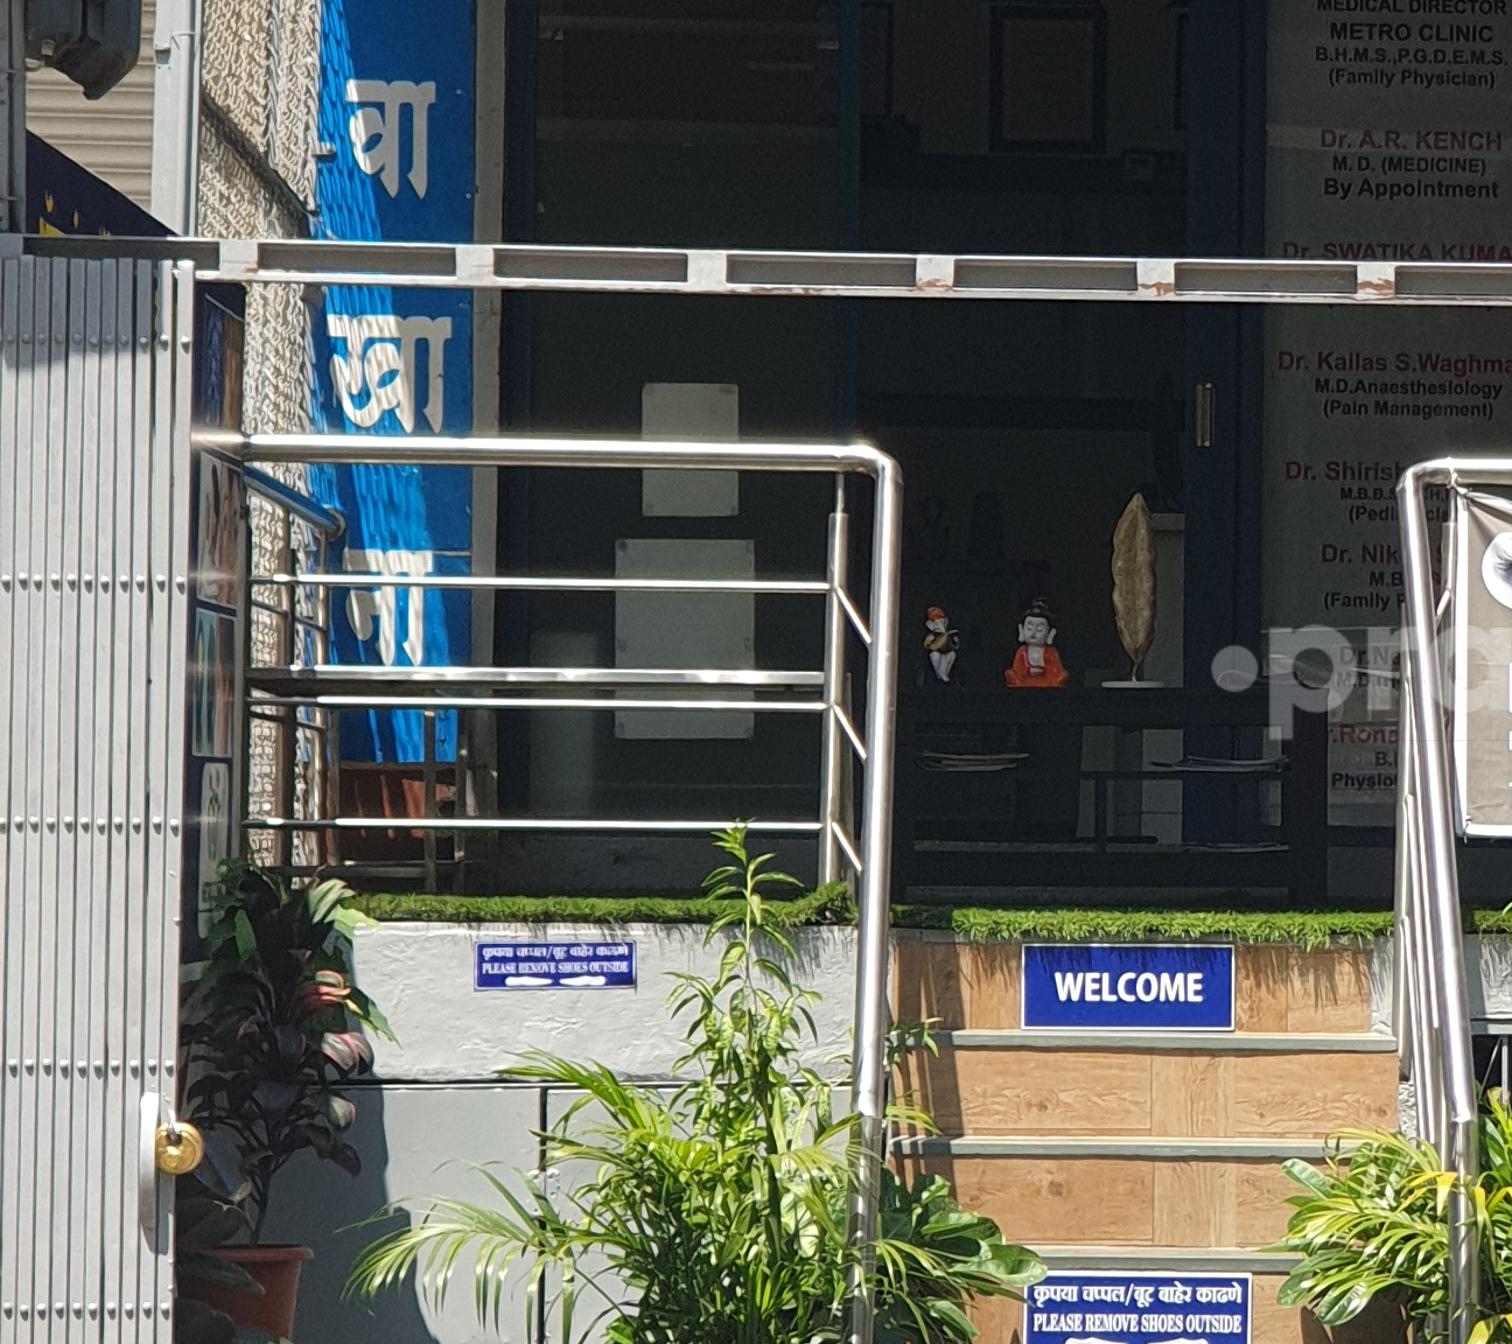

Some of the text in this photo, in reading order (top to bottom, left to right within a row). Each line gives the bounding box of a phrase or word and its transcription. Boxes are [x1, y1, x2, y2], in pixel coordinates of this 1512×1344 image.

[1329, 22, 1494, 43] METRO CLINIC
[1328, 68, 1496, 89] (Family Physician)
[1415, 130, 1503, 152] KENCH
[1381, 156, 1486, 176] (MEDICINE)
[1323, 178, 1500, 201] By Appointment
[482, 962, 629, 974] PLEASE REMOVE SHOES OUTSIDE
[1054, 971, 1204, 1003] WELCOME
[1033, 1285, 1078, 1308] कृपया
[1158, 1281, 1191, 1304] बाहेर
[1196, 1282, 1242, 1304] काढणे
[1033, 1313, 1242, 1333] PLEASE REMOVE SHOES OUTSIDE
